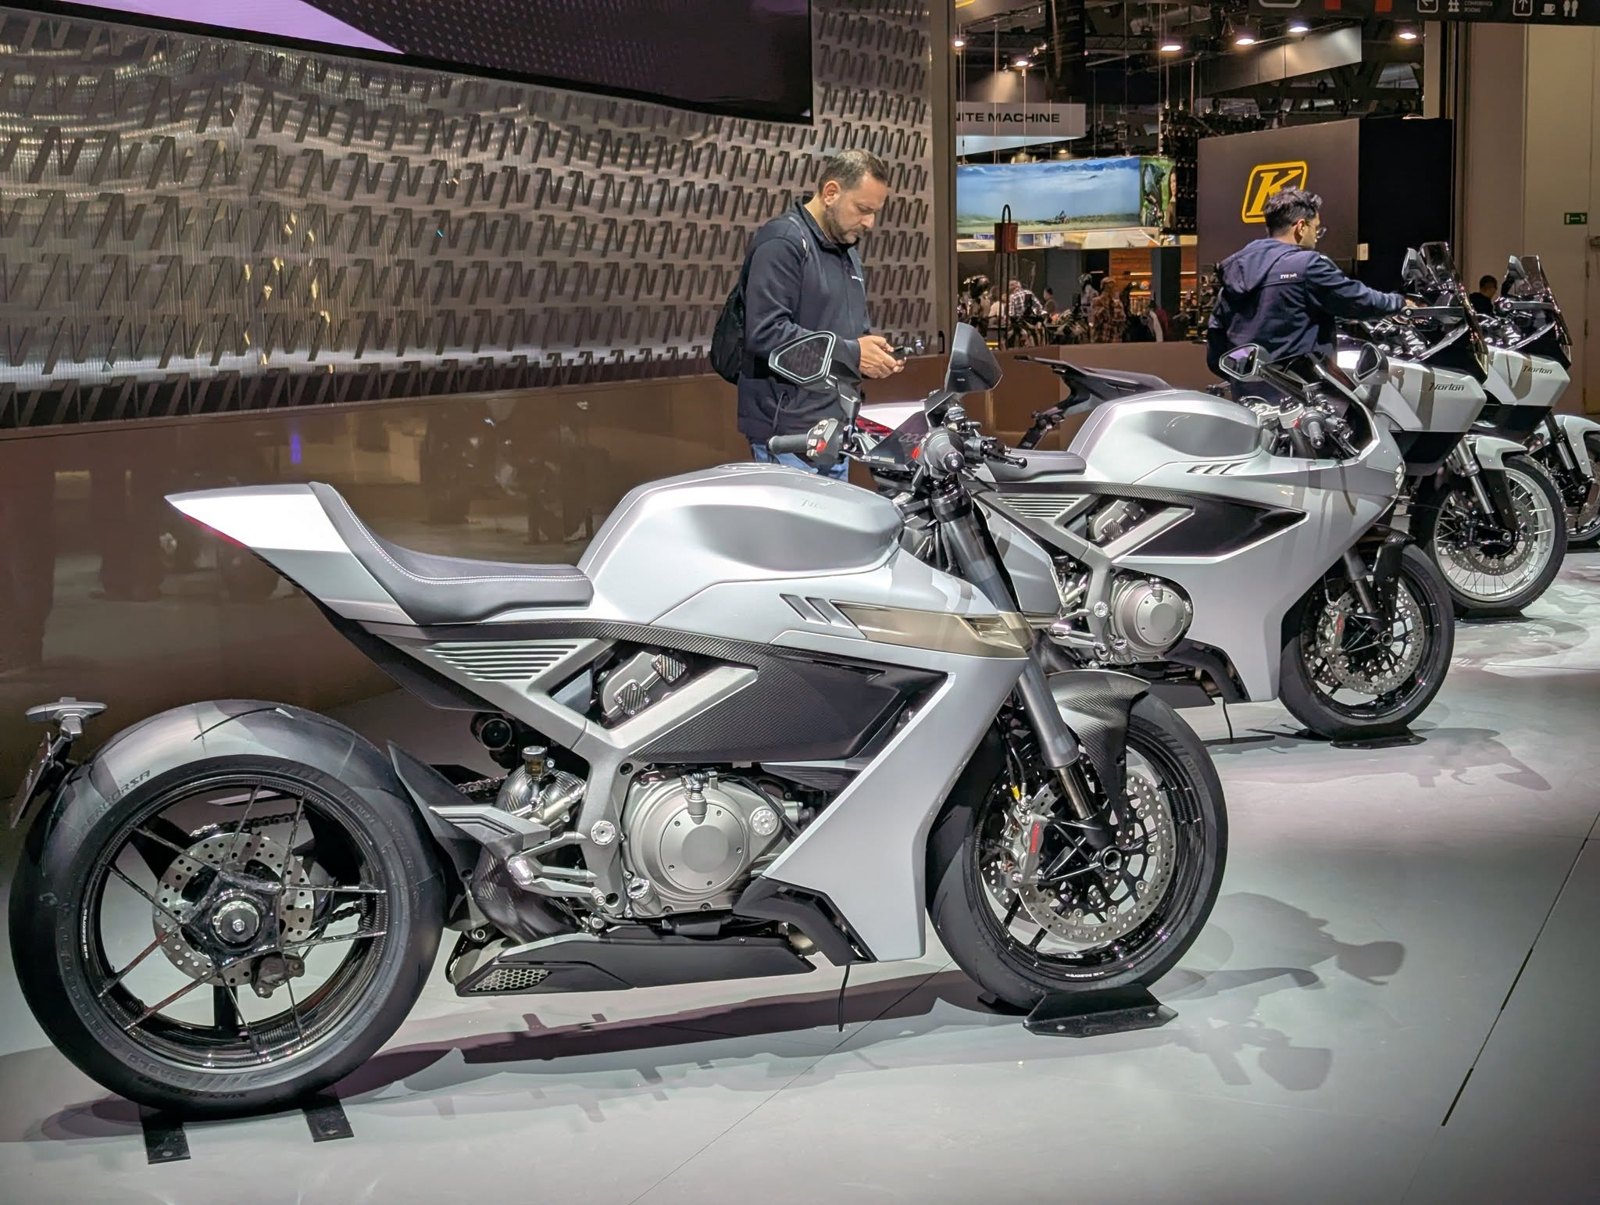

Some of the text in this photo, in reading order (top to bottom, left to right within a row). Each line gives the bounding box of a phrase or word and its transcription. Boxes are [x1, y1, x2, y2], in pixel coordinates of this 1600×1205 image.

[988, 112, 1060, 123] MACHINE
[1522, 365, 1553, 375] Norton
[1427, 382, 1465, 392] Norton
